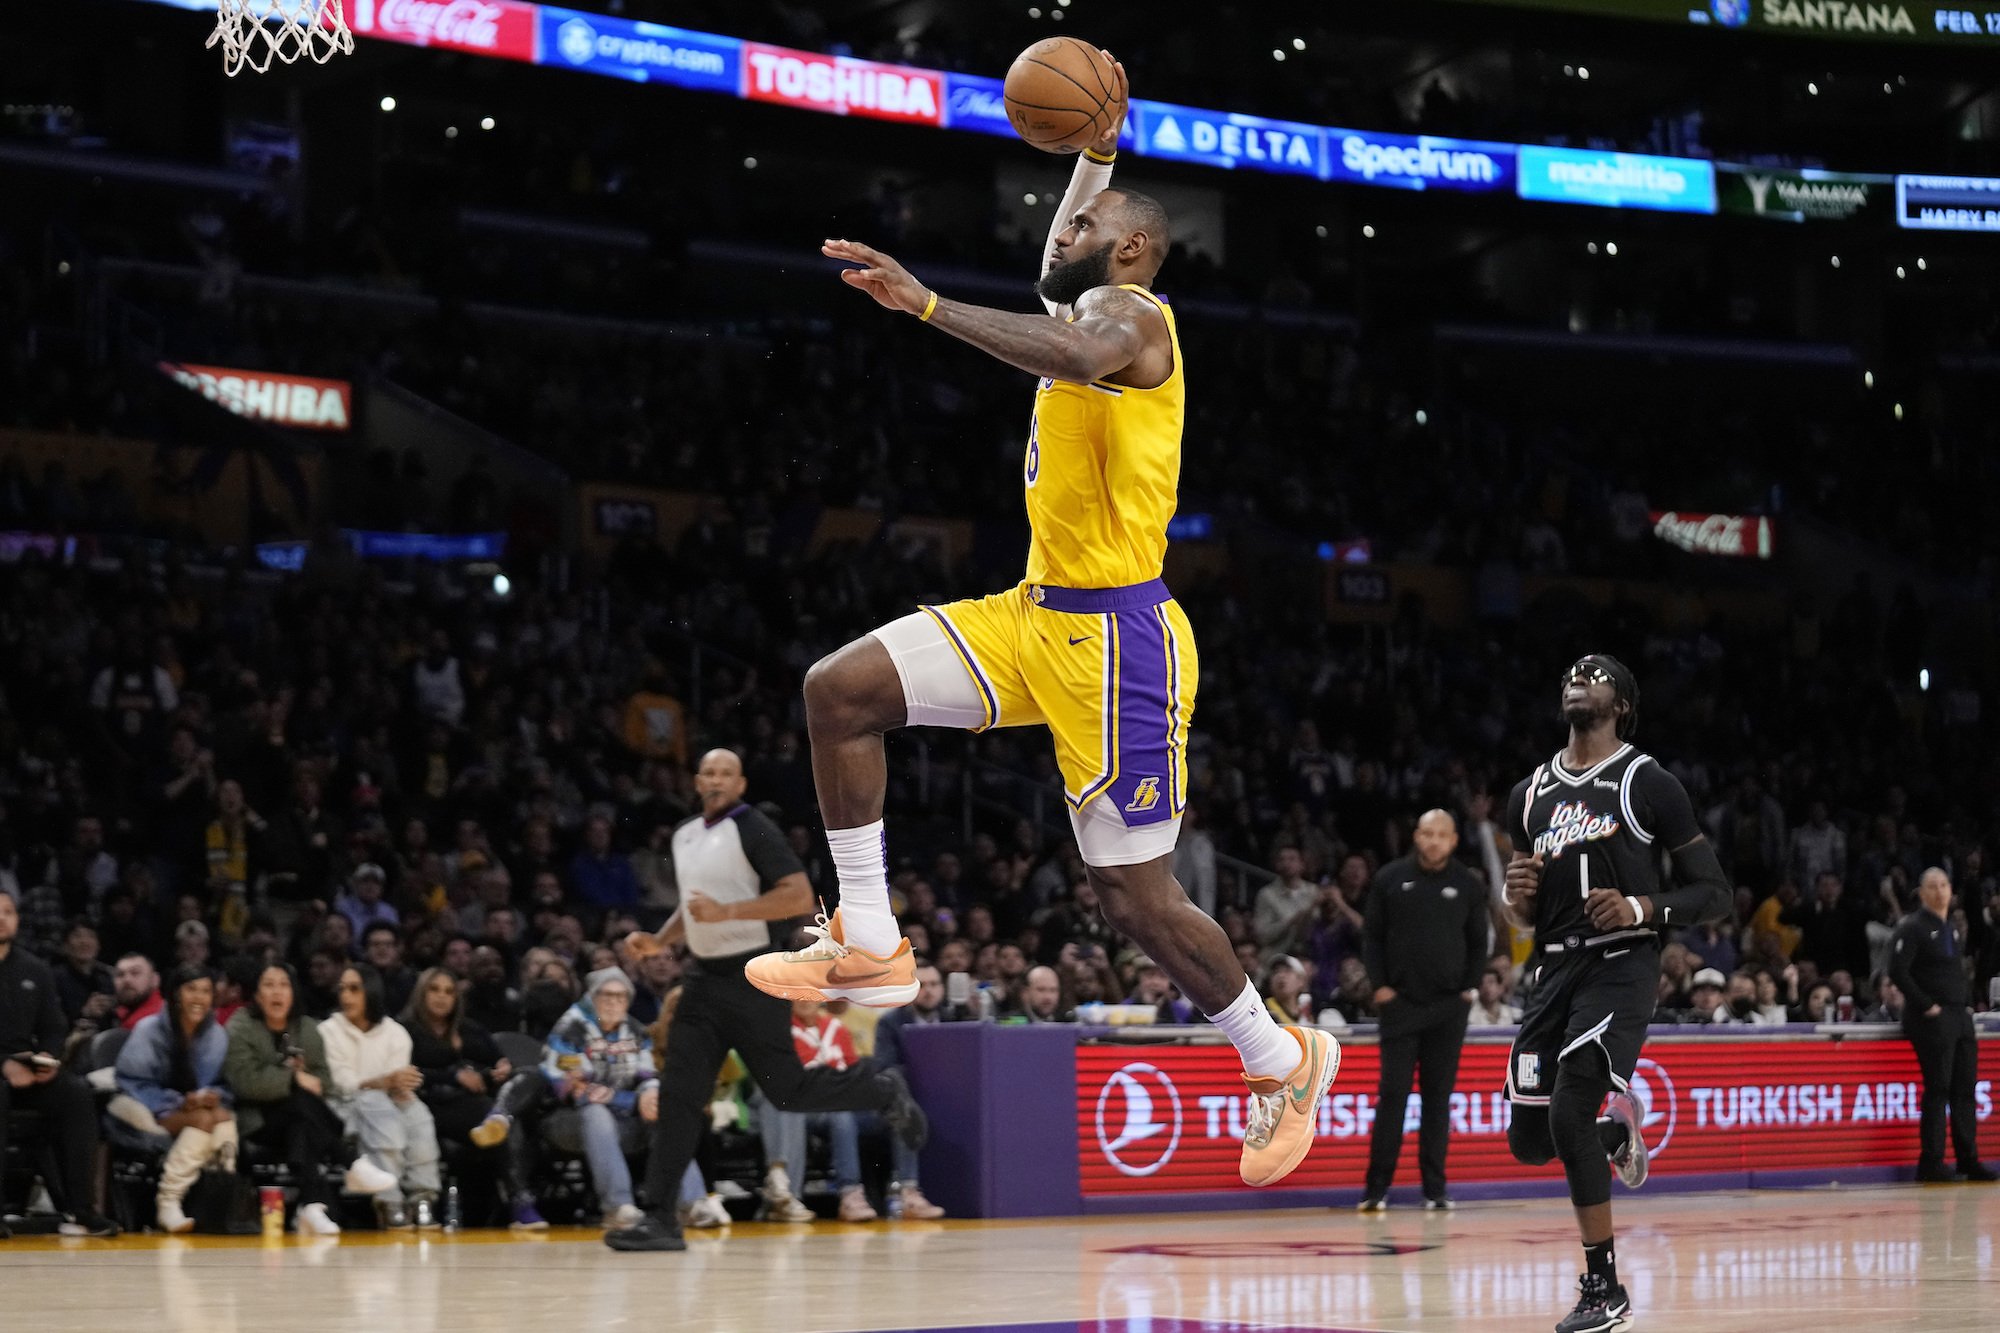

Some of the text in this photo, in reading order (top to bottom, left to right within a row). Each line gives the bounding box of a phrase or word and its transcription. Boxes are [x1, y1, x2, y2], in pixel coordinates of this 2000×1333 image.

[1763, 0, 1916, 34] SANTANA
[597, 35, 725, 75] crypto.com
[751, 52, 936, 117] TOSHIBA
[1192, 120, 1313, 167] DELTA
[1342, 136, 1494, 182] Spectrum
[1593, 777, 1619, 791] honey
[1580, 853, 1589, 899] 1
[1198, 1094, 1377, 1139] TUISH
[1690, 1080, 1993, 1128] TURKISH AIRLS
